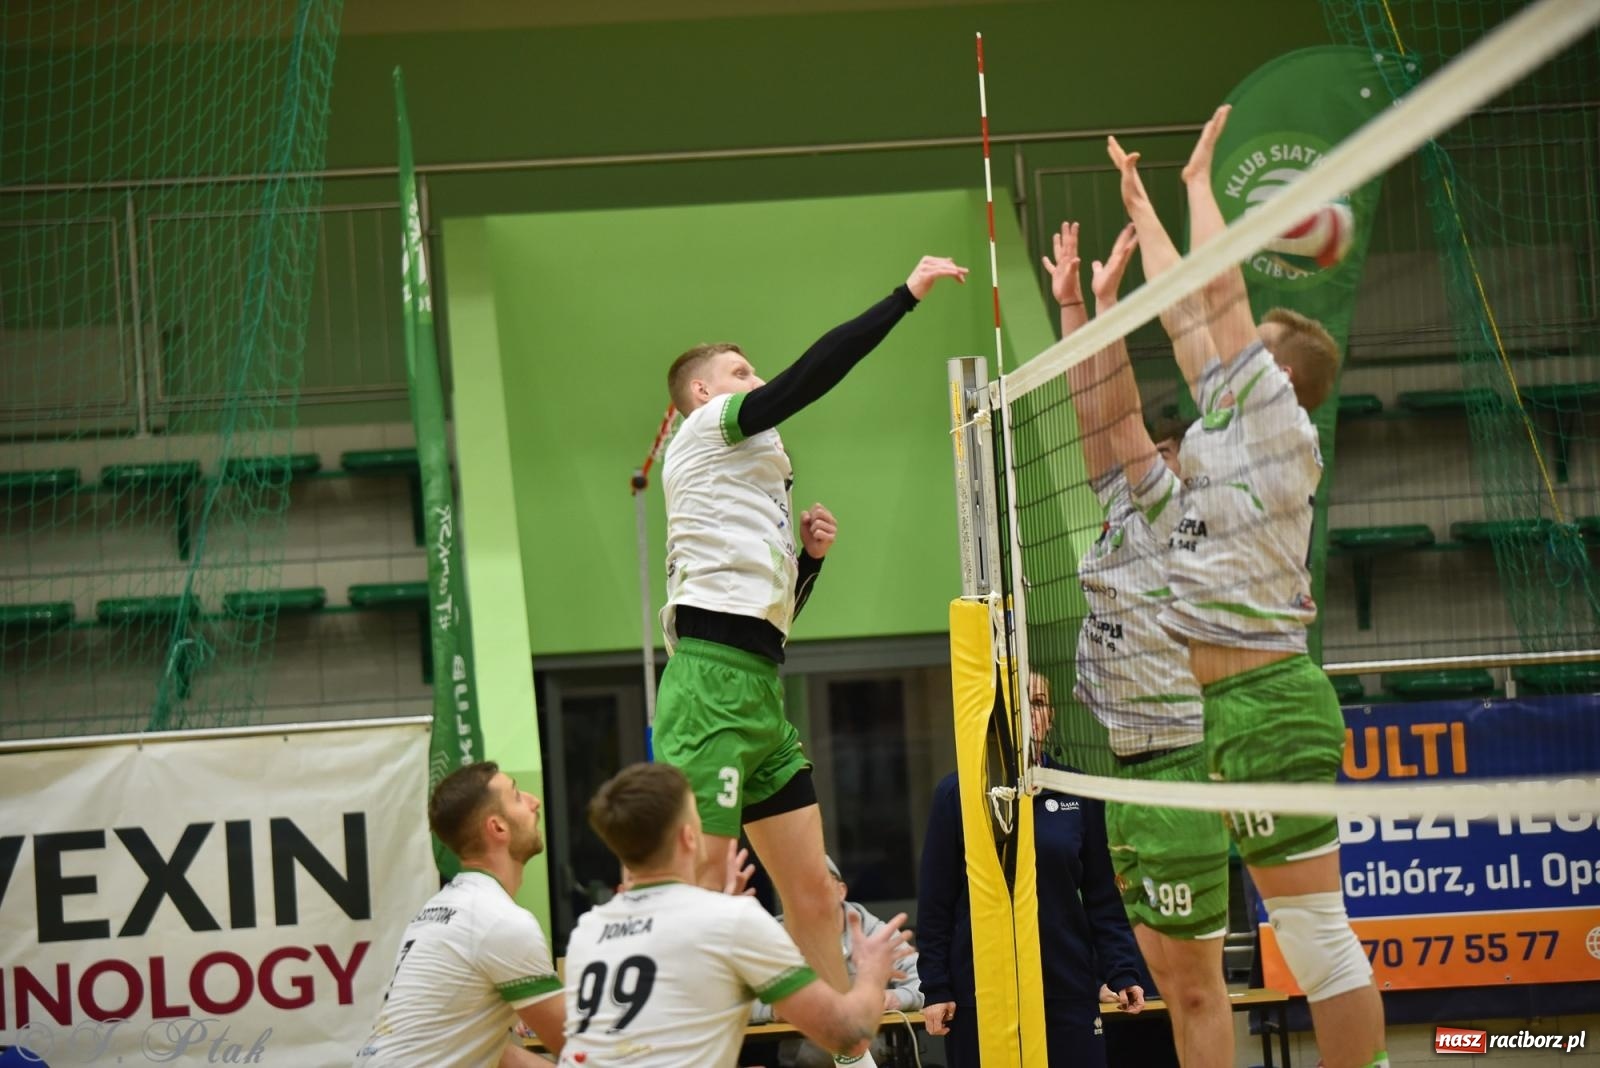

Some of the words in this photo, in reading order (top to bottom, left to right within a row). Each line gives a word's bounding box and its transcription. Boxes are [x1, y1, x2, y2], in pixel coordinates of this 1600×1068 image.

[1225, 151, 1267, 198] KLUB
[1342, 722, 1468, 780] ULTI
[717, 766, 740, 808] 3
[1337, 779, 1600, 844] BEZPIEC
[1344, 858, 1476, 898] cibórz,
[1485, 854, 1532, 890] ul.
[1542, 852, 1600, 895] Op
[1158, 883, 1193, 917] 99
[597, 915, 654, 945] JOŃCA
[1361, 938, 1404, 968] 70
[1412, 935, 1454, 966] 77
[1465, 932, 1509, 963] 55
[1517, 930, 1559, 961] 77
[0, 941, 371, 1030] NOLOGY
[570, 954, 658, 1036] 99
